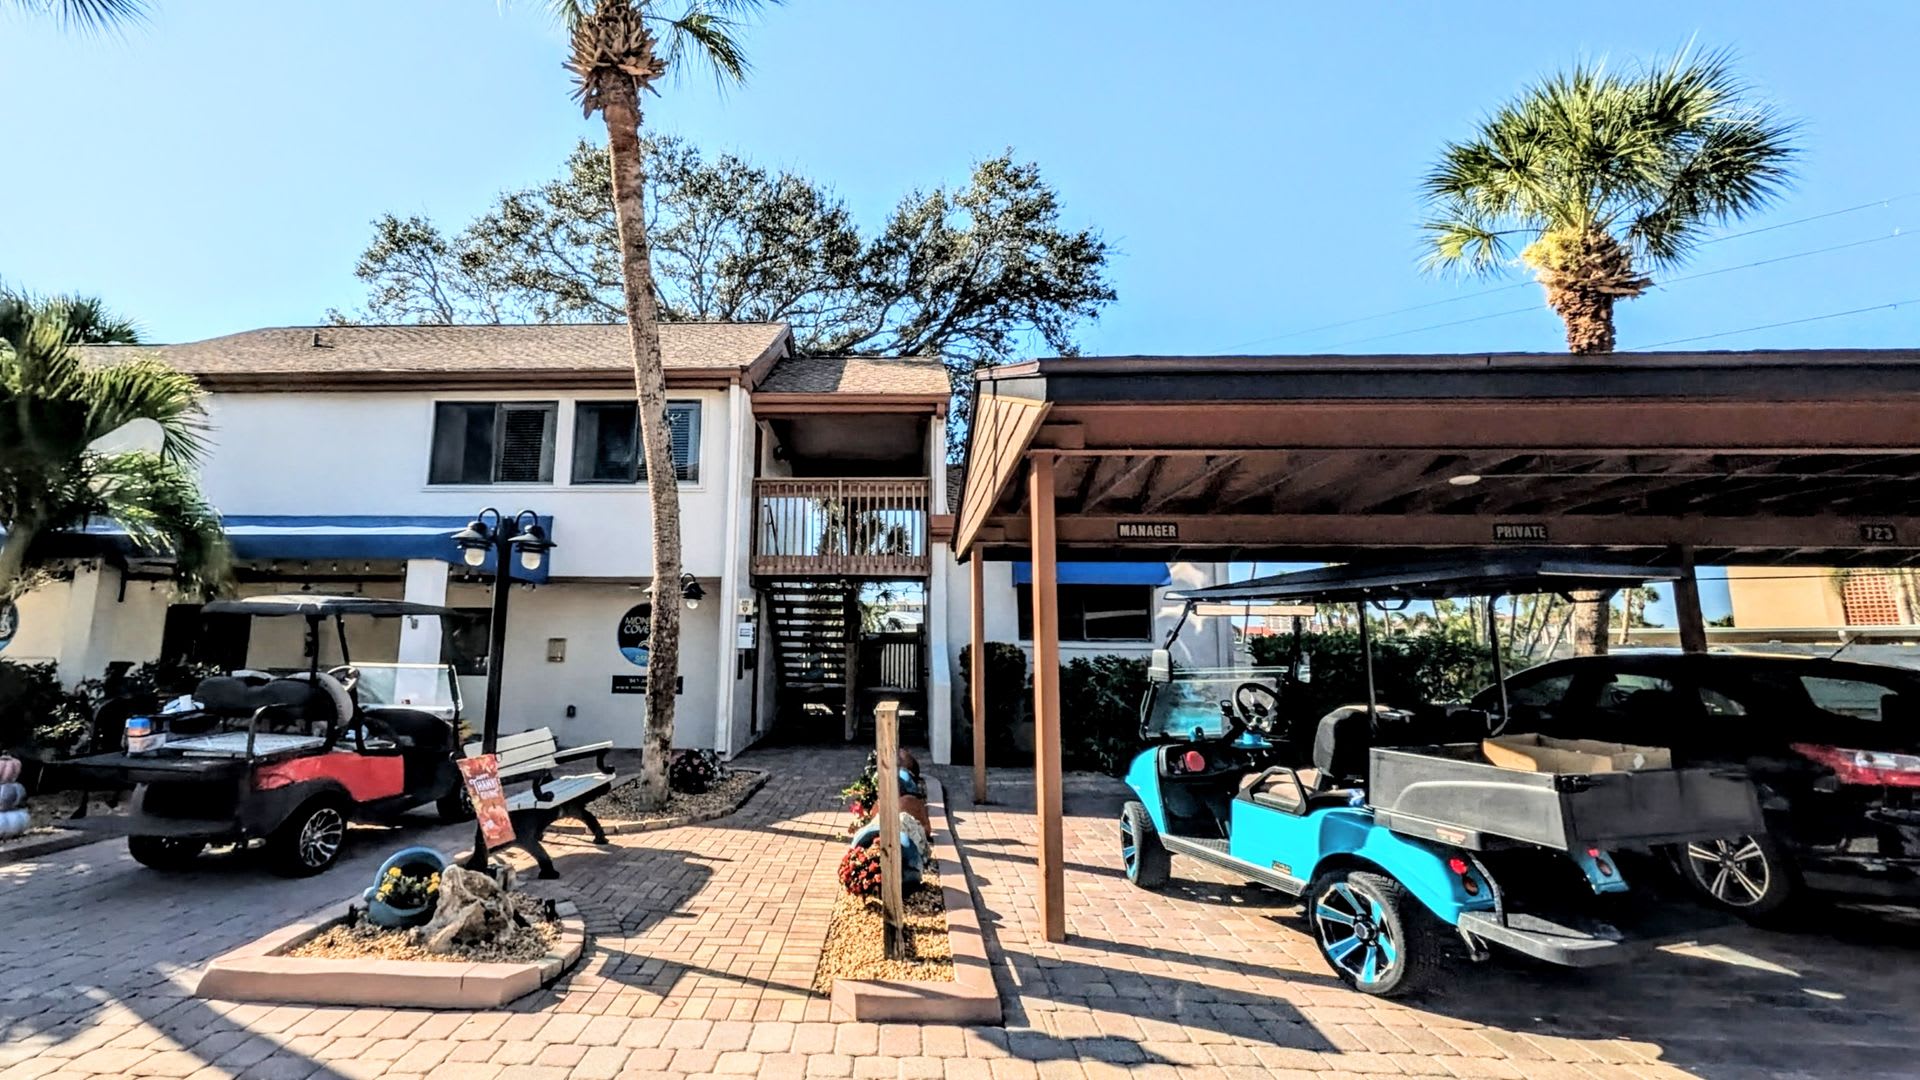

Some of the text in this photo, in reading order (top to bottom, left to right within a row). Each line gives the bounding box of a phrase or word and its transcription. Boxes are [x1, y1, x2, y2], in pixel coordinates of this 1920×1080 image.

[1120, 524, 1176, 537] MANAGER
[1496, 526, 1546, 538] PRIVATE
[624, 625, 649, 634] COVE
